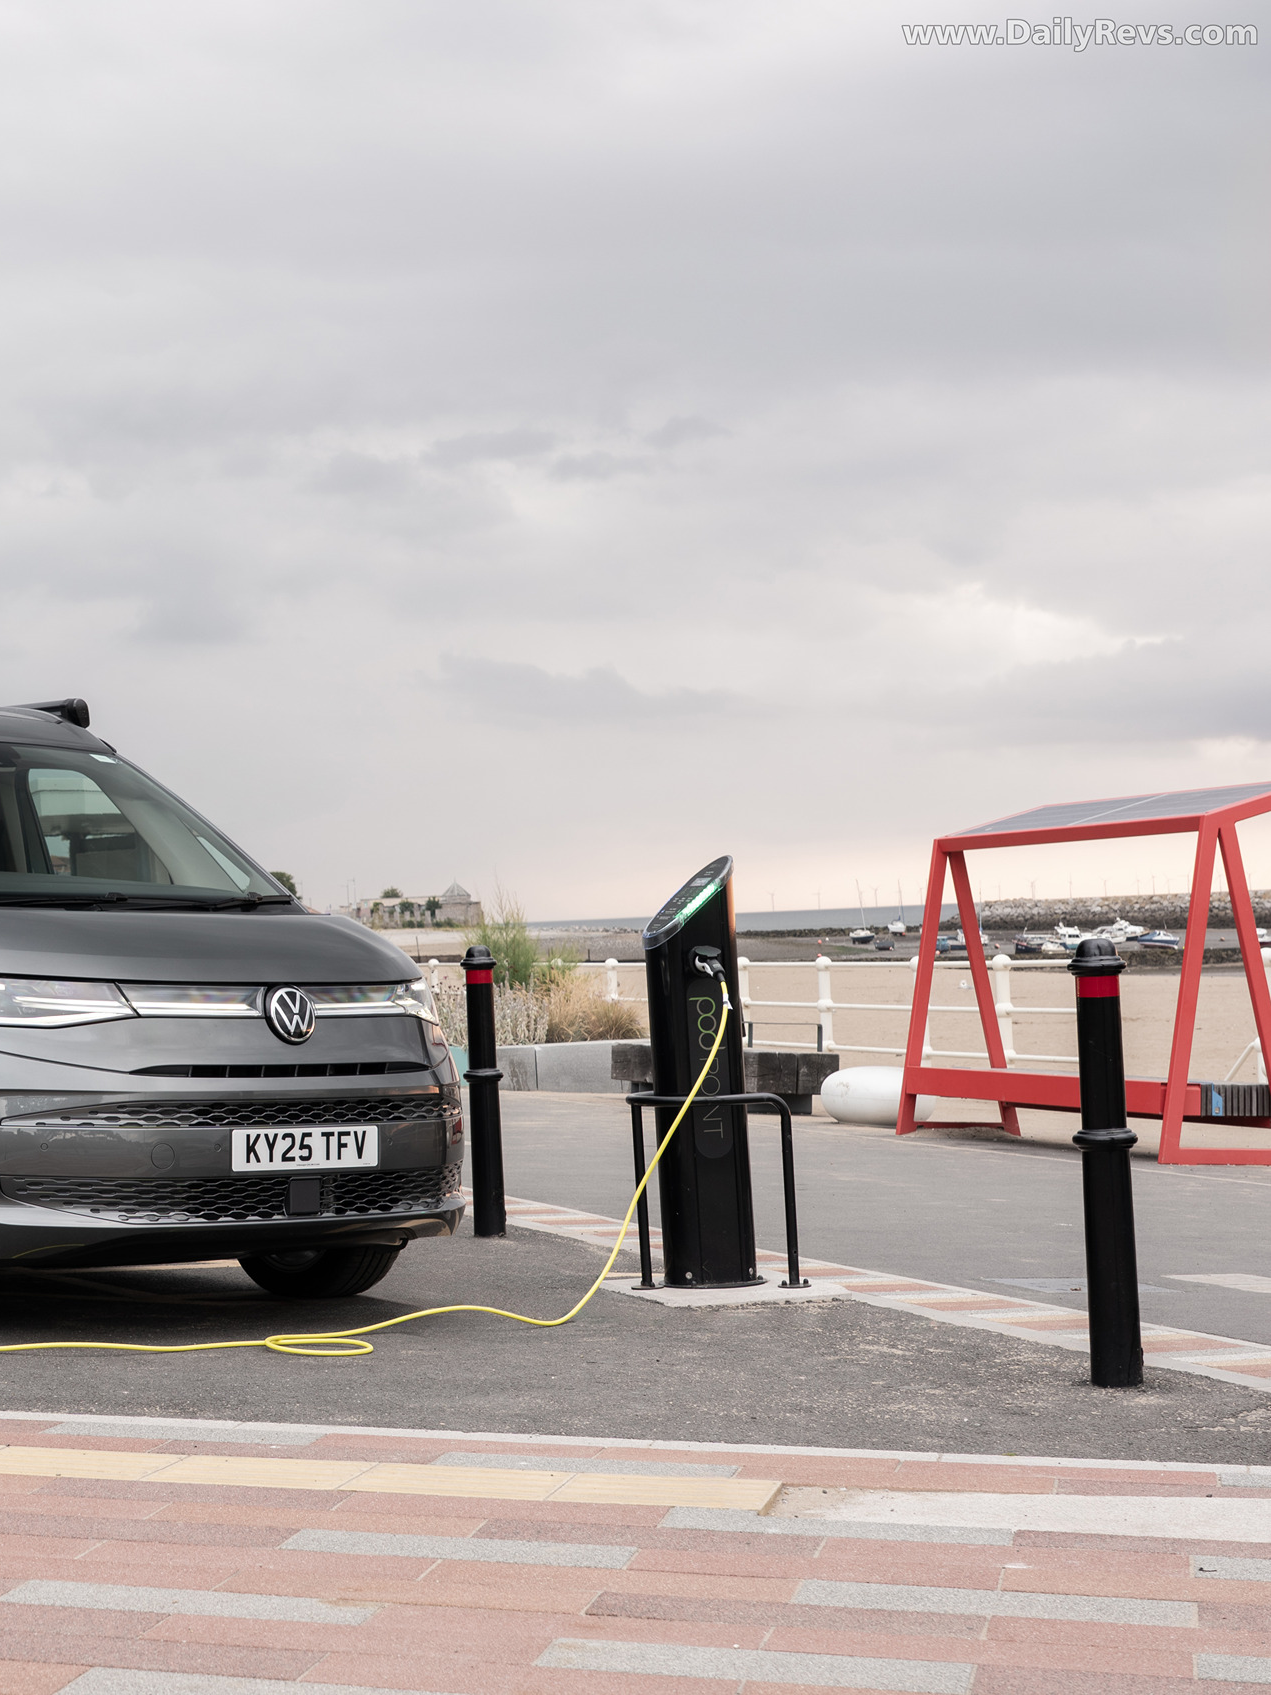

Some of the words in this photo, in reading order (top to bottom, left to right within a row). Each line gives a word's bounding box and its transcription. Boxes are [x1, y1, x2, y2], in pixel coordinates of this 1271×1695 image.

[699, 1057, 724, 1139] PONT
[245, 1132, 313, 1164] KY25
[321, 1130, 367, 1161] TFV
